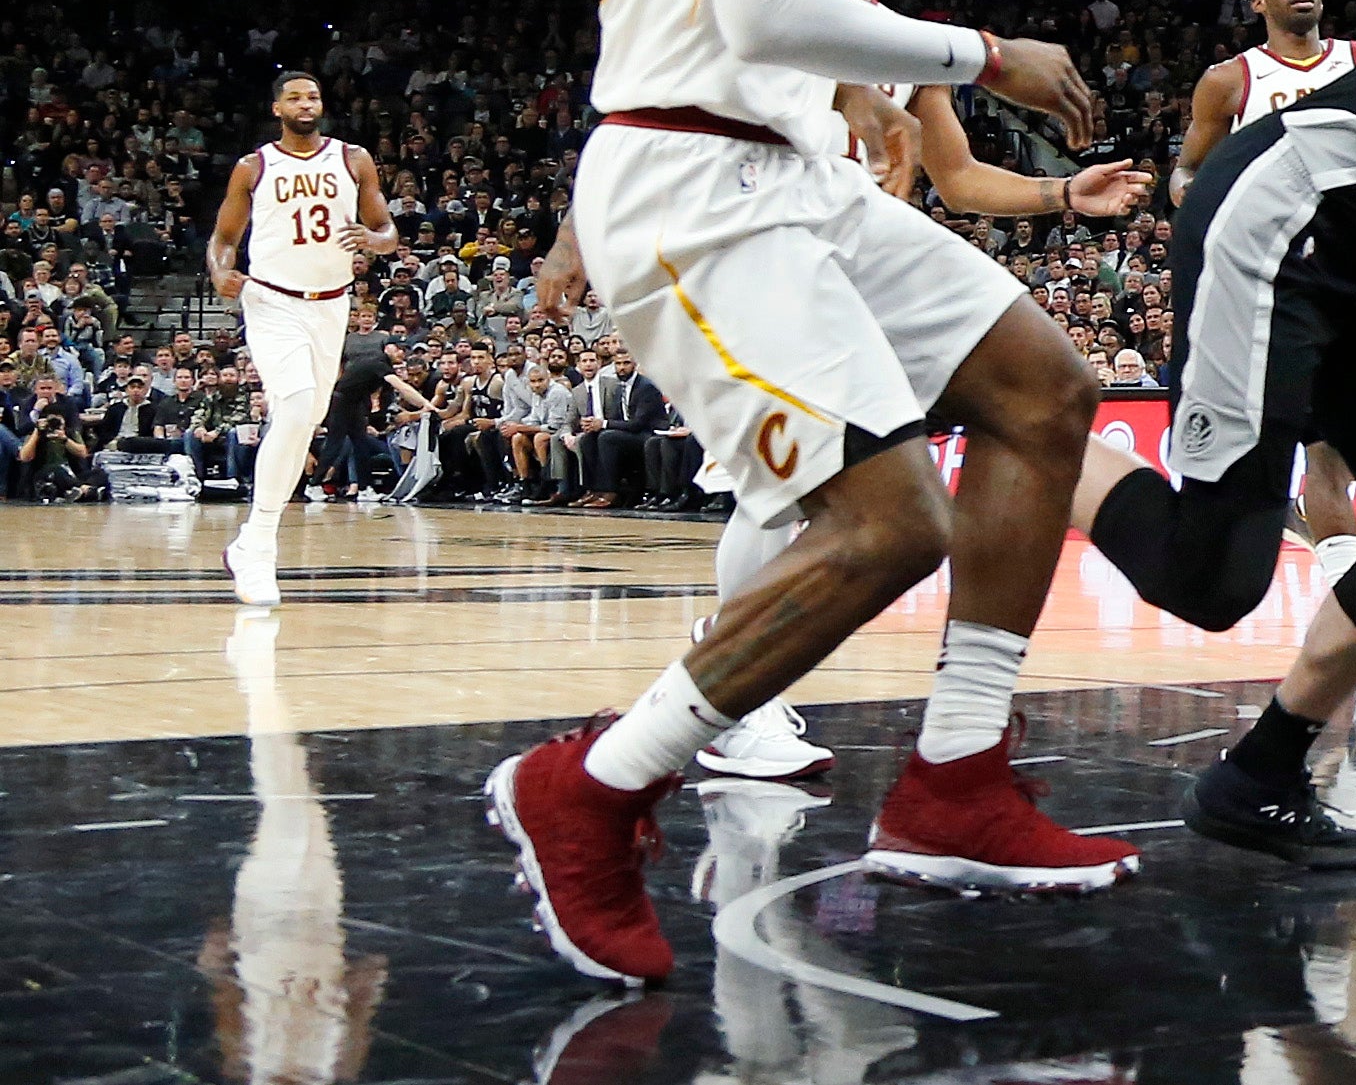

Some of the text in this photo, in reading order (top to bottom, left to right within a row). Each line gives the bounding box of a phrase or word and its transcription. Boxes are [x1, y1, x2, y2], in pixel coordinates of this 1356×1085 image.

[275, 173, 338, 203] CAVS
[291, 203, 331, 246] 13
[757, 410, 798, 481] C
